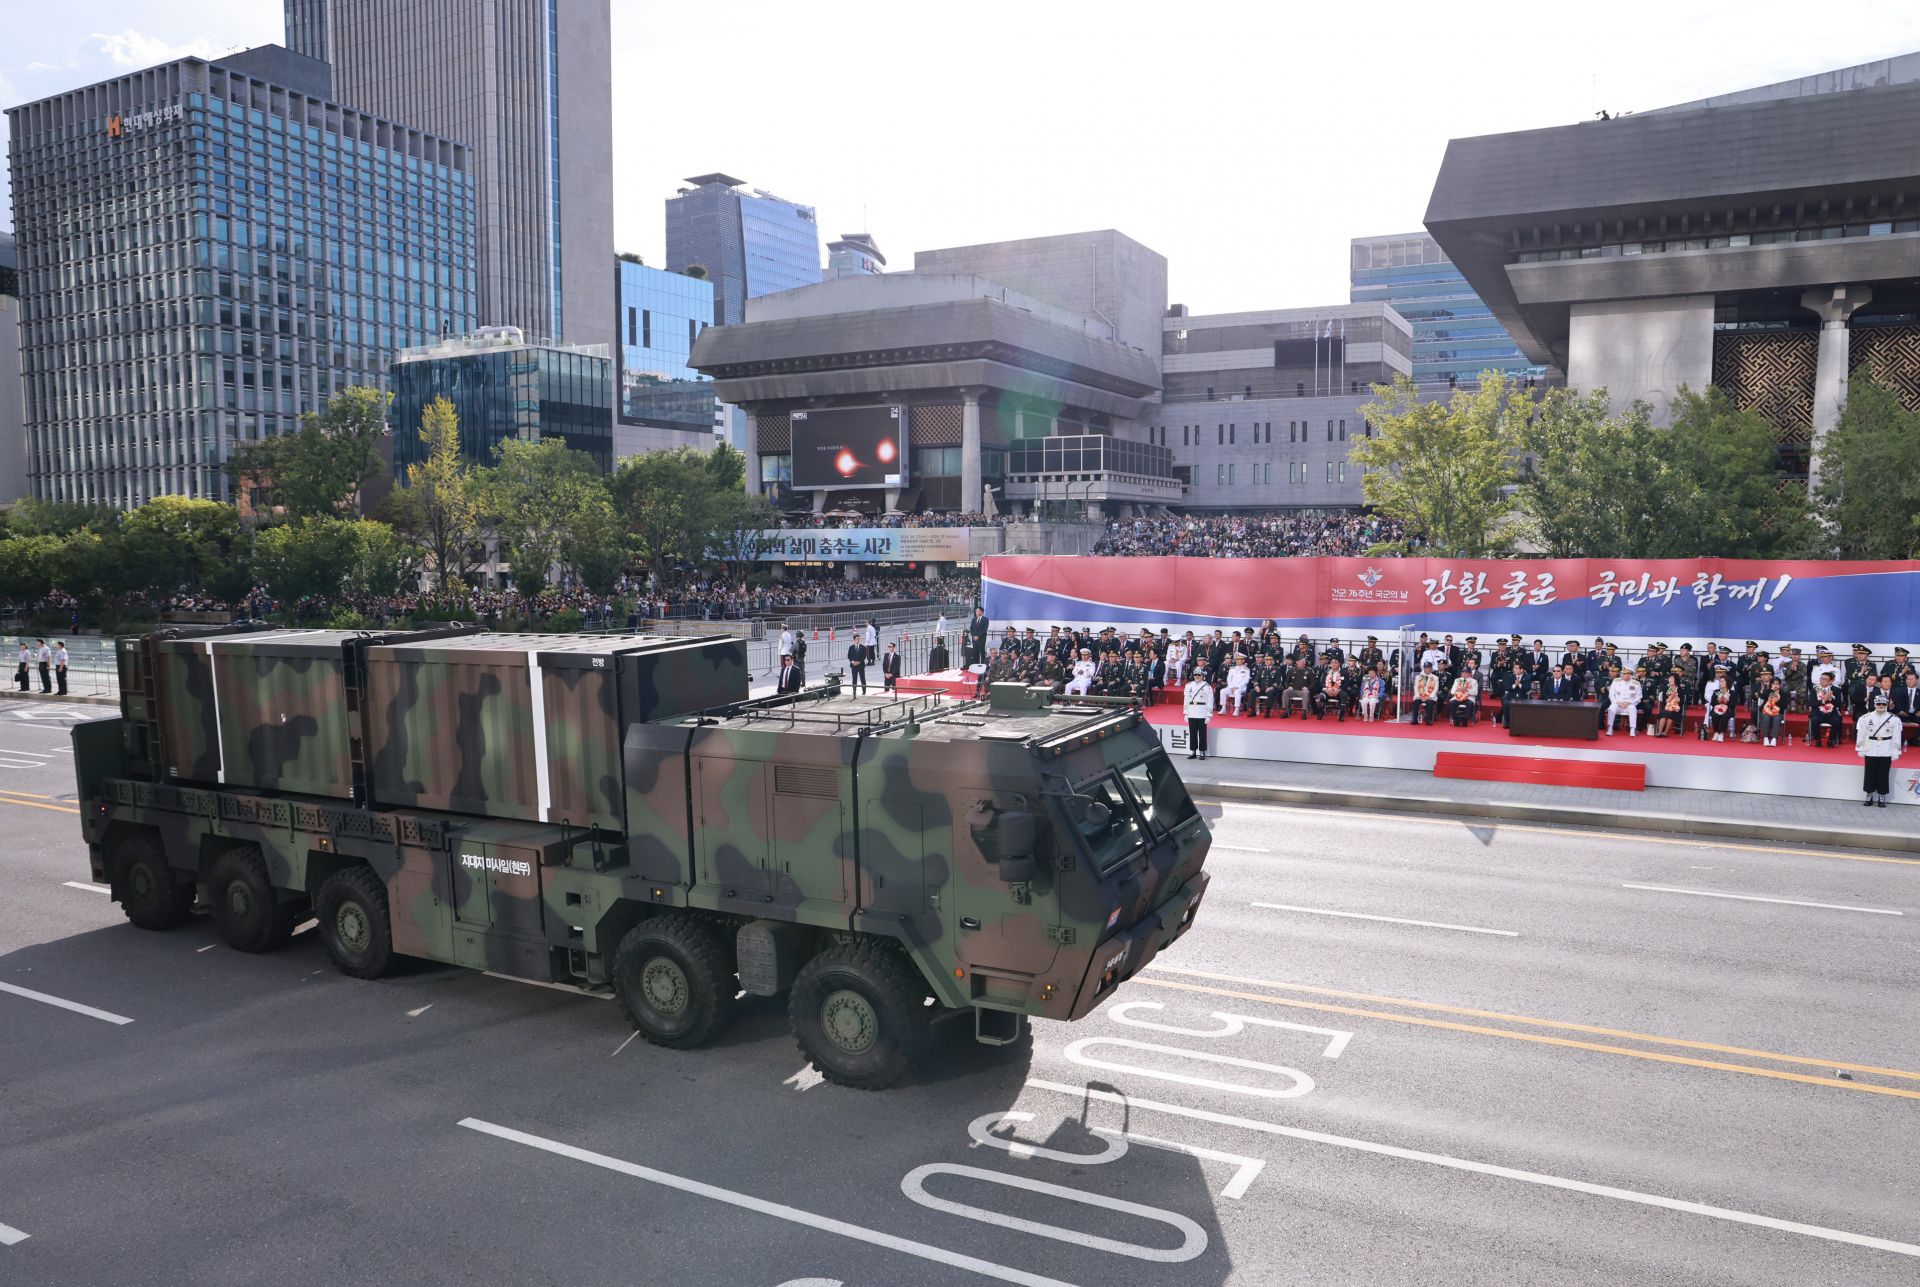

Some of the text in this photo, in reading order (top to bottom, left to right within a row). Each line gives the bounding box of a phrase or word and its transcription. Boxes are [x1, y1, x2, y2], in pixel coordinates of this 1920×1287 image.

[124, 104, 183, 132] 현대해상화재
[790, 537, 816, 555] 삶이
[819, 537, 860, 555] 춤추는
[864, 537, 892, 555] 시간
[1331, 588, 1347, 598] 건군
[1375, 589, 1398, 599] 국군의
[1400, 590, 1409, 599] 날
[1422, 568, 1793, 613] 강한 국군 국민과 함께!
[1171, 729, 1190, 749] 날
[461, 853, 531, 877] 지대지 미사일(현무)
